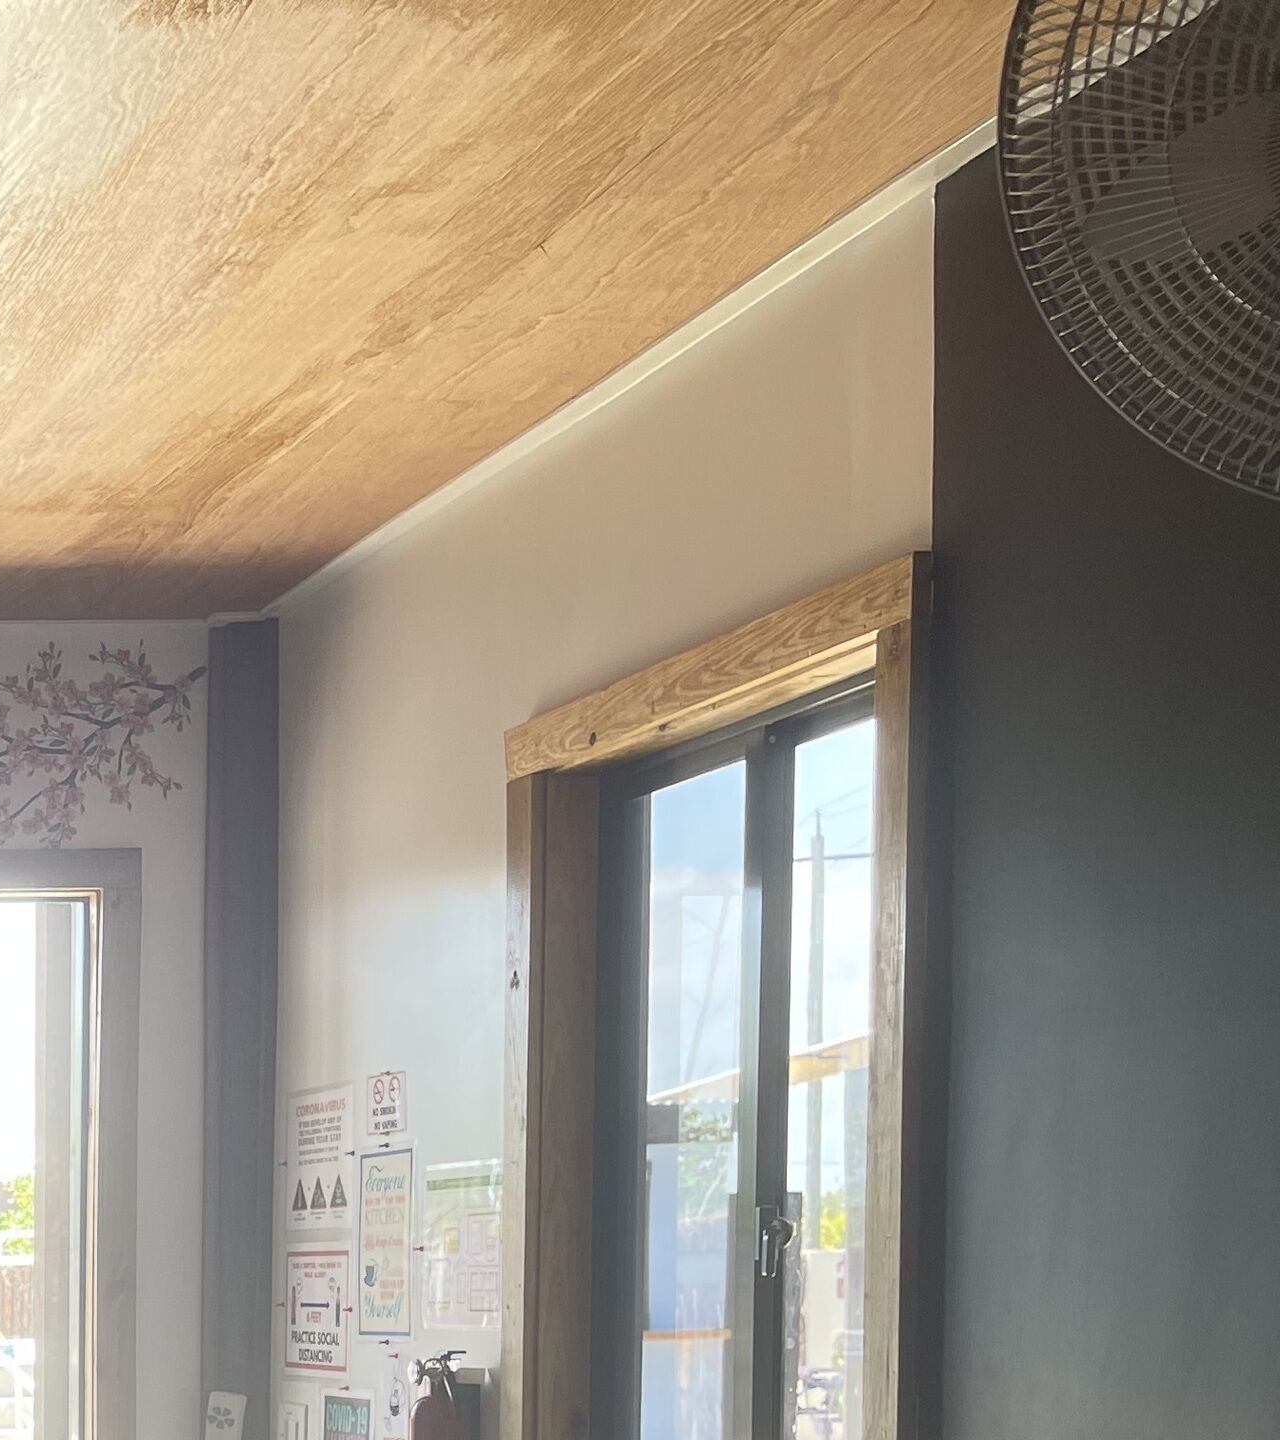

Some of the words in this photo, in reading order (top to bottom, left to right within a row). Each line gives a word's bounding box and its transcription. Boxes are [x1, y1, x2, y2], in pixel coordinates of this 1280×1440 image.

[296, 1098, 346, 1117] CORONAVIRUS
[365, 1207, 405, 1225] KITCHEN
[291, 1330, 316, 1344] PRACTICE
[317, 1332, 339, 1346] SOCIAL
[298, 1348, 333, 1363] DISTANCING
[326, 1403, 368, 1434] COVID-19
